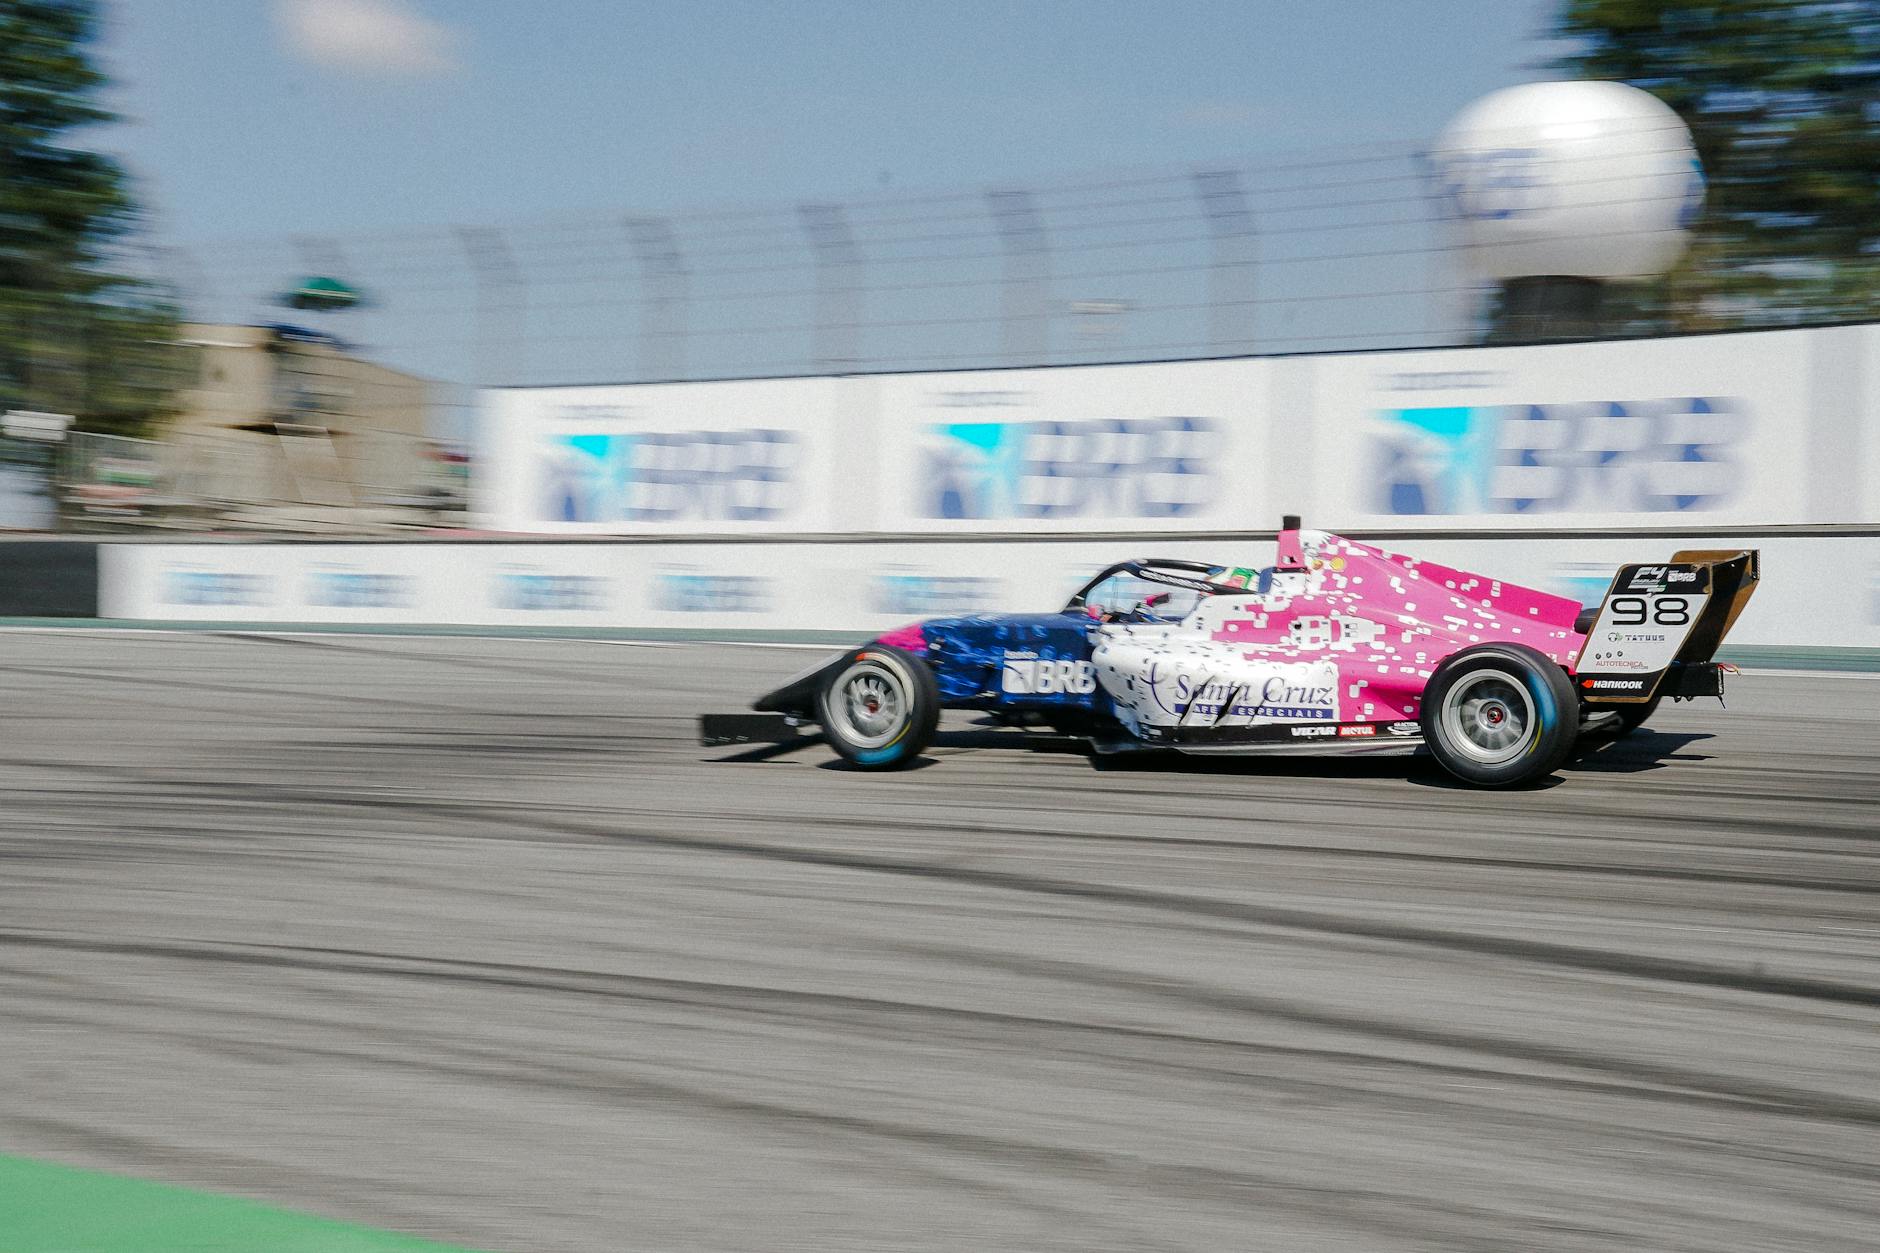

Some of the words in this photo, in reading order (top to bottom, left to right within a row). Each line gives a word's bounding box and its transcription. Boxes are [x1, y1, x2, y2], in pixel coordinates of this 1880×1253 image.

[1633, 566, 1668, 580] F4
[1611, 597, 1690, 626] 98
[1624, 634, 1665, 642] TATUUS
[1595, 660, 1644, 668] AUTOTECNICA
[1035, 660, 1096, 694] BRB
[1175, 674, 1250, 702] Santa
[1262, 676, 1333, 706] Cruz
[1238, 707, 1324, 718] ESPECIAIS
[1340, 726, 1375, 736] MOTUL
